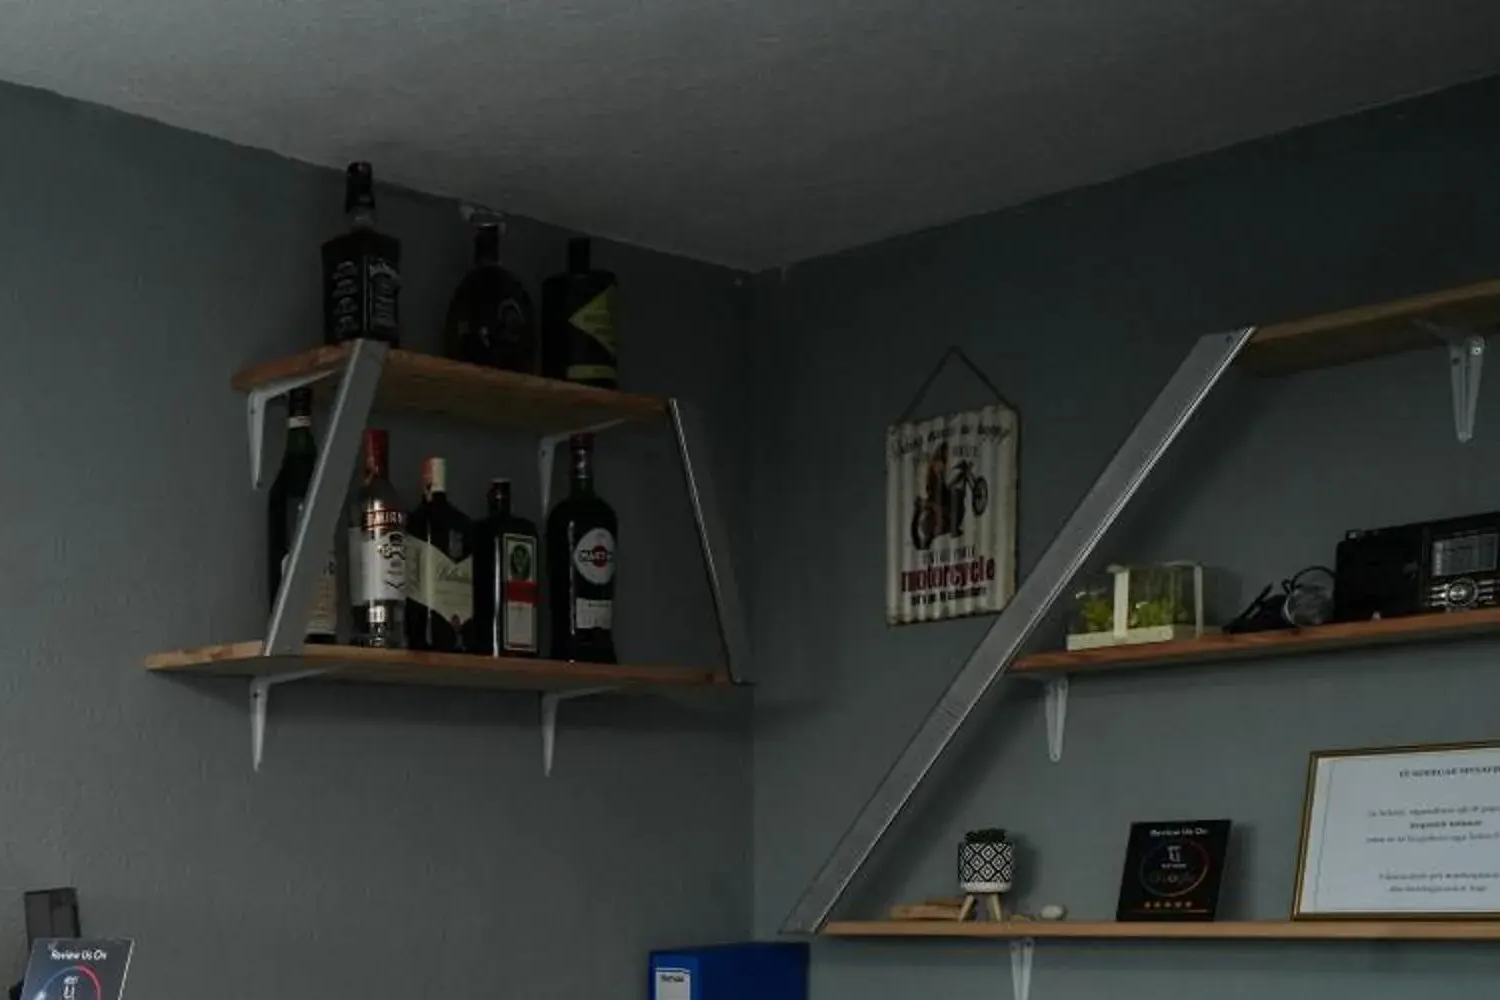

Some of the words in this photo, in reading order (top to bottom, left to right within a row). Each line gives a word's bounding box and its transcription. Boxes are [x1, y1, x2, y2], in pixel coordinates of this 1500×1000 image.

[51, 949, 80, 960] Review
[81, 950, 93, 960] Us
[93, 949, 108, 960] On
